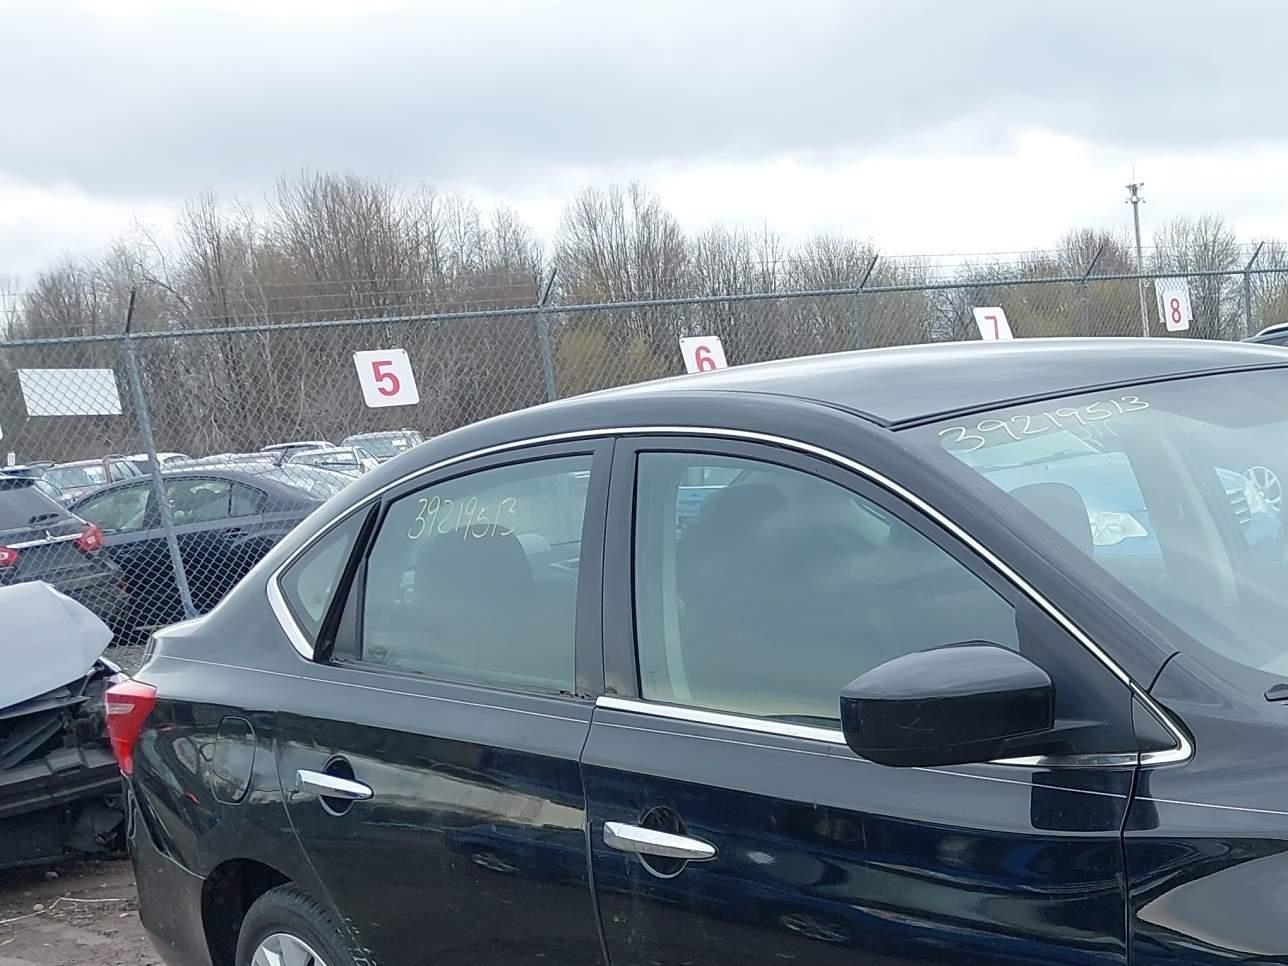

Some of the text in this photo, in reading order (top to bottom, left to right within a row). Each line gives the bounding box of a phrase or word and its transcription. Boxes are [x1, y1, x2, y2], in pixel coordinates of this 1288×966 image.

[1170, 298, 1181, 323] 8
[984, 315, 999, 340] 7
[694, 345, 716, 372] 6
[371, 360, 400, 397] 5
[938, 396, 1150, 452] 39219513
[408, 495, 517, 540] 39219513
